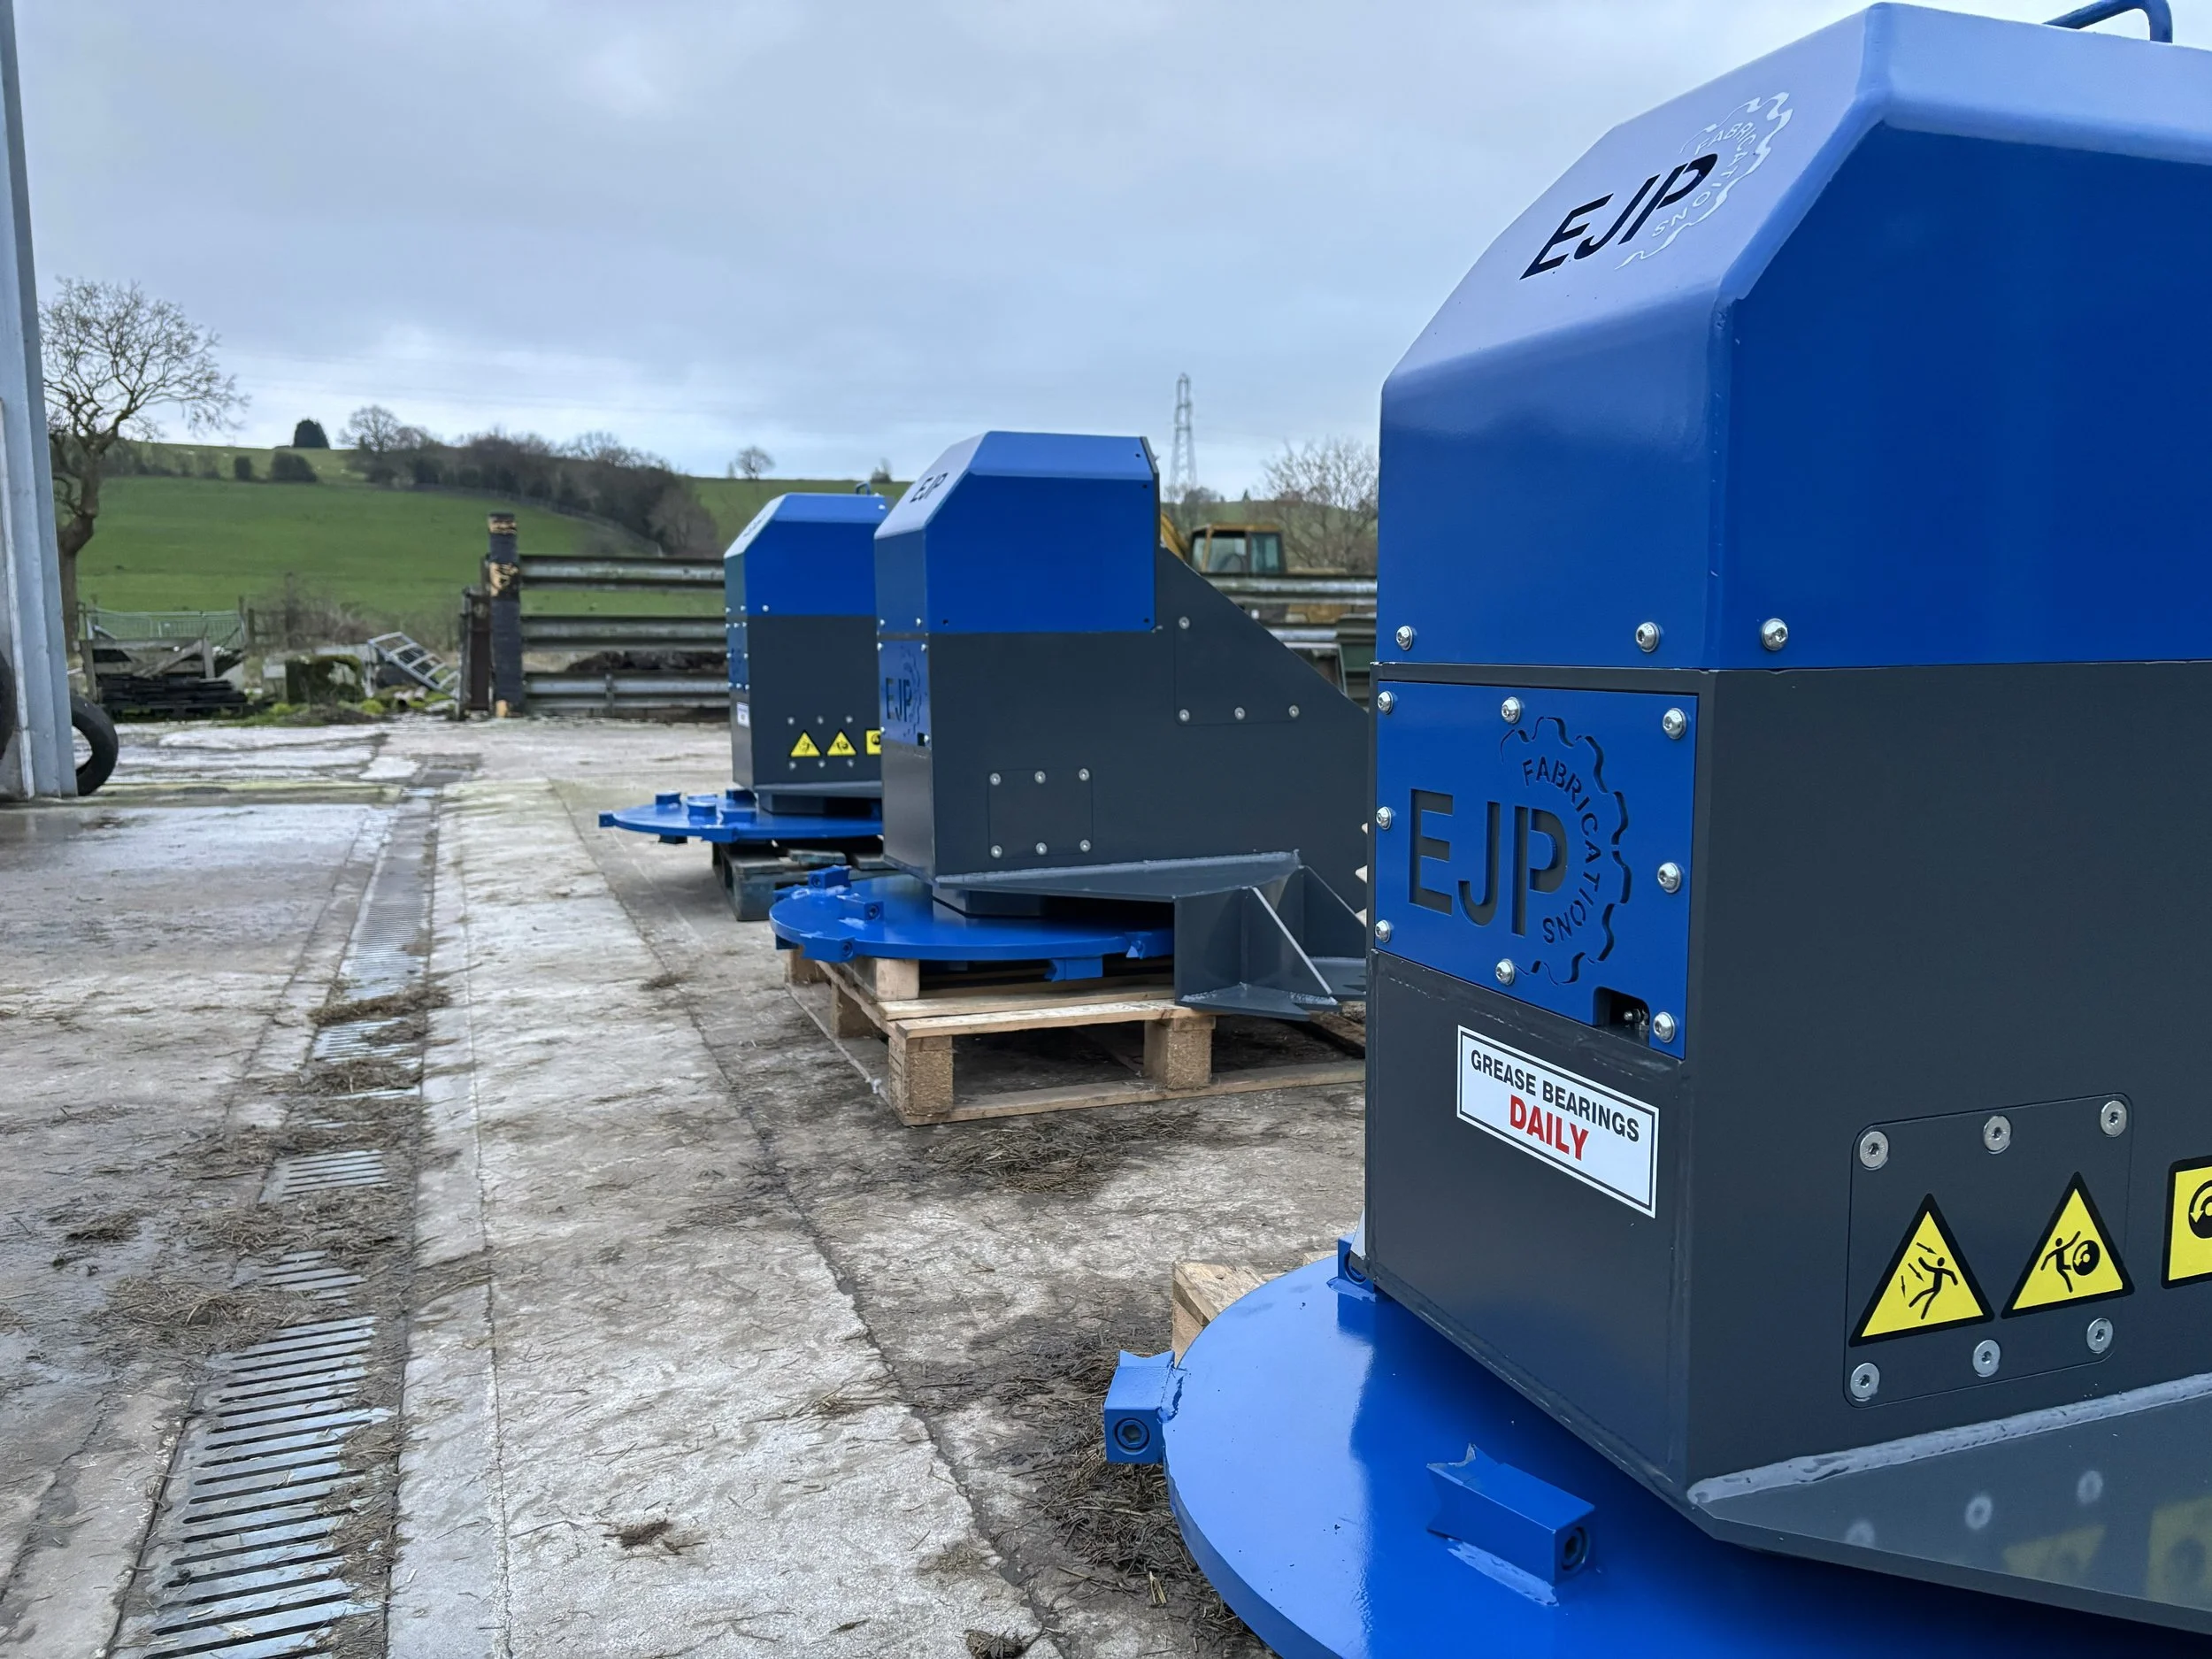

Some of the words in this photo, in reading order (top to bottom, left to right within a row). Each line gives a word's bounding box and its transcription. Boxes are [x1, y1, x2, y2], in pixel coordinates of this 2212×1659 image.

[1519, 153, 1718, 280] EJP
[1651, 121, 1757, 238] FABRICATIONS
[886, 677, 912, 722] EJP
[1409, 788, 1568, 938] EJP
[1521, 756, 1601, 945] FABRICATIONS
[1471, 1049, 1537, 1096] GREASE
[1542, 1079, 1640, 1142] BEARINGS
[1509, 1094, 1589, 1161] DAILY
